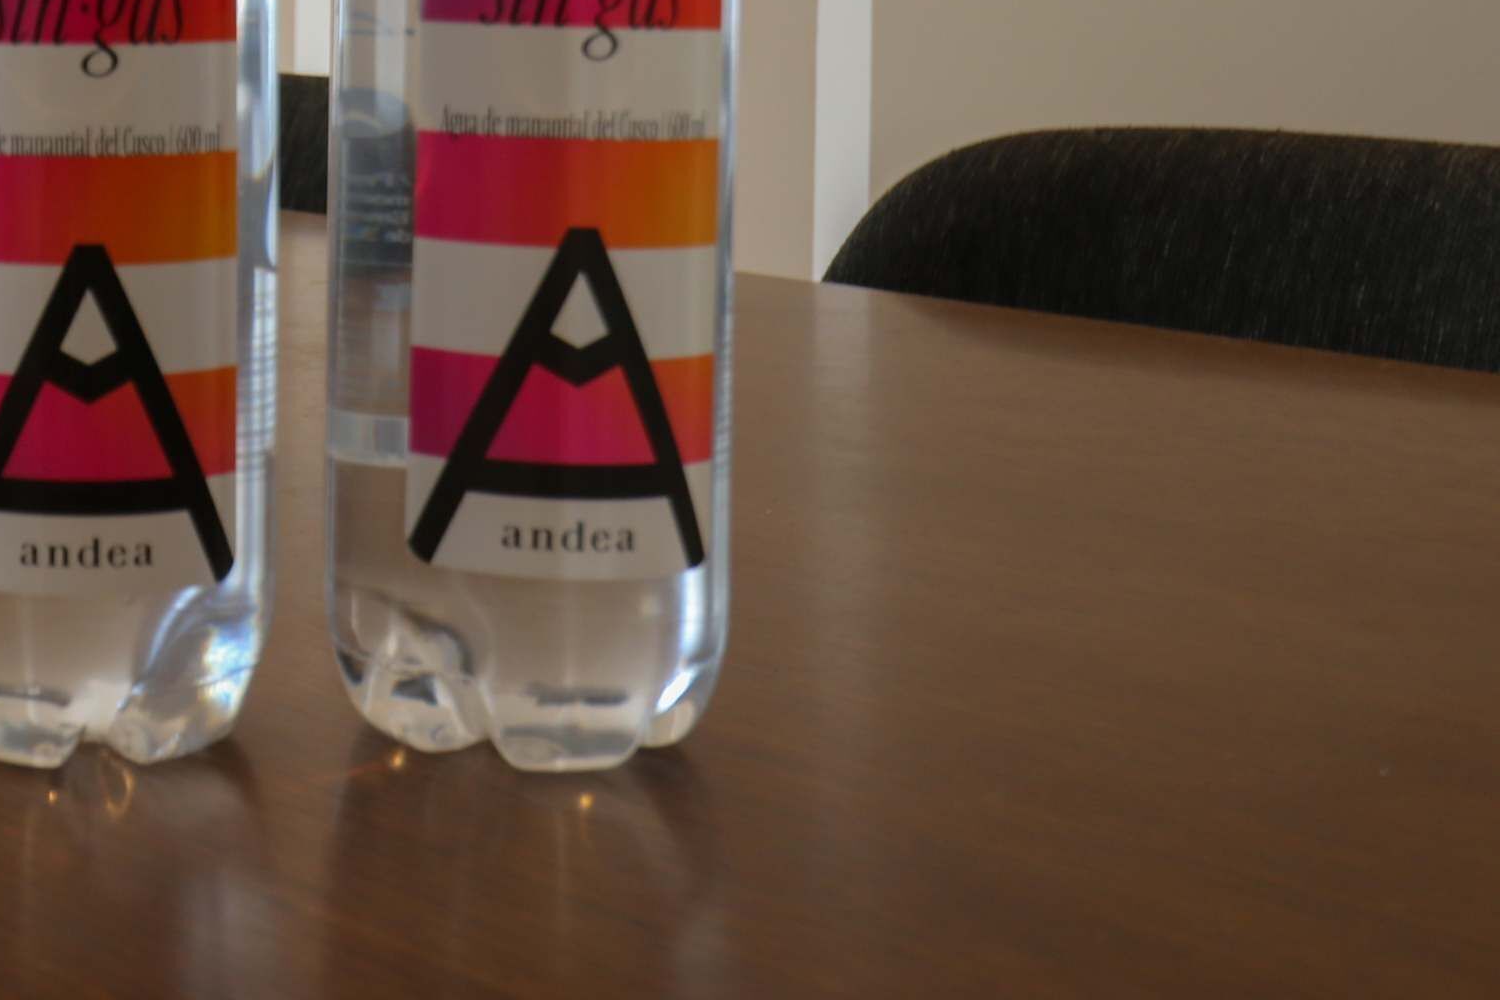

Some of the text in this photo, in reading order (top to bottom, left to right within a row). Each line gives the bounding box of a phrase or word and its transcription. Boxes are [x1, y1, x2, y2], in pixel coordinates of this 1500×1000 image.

[95, 125, 118, 157] del
[123, 125, 165, 156] Cusco
[19, 534, 153, 569] andea
[500, 520, 636, 553] andea
